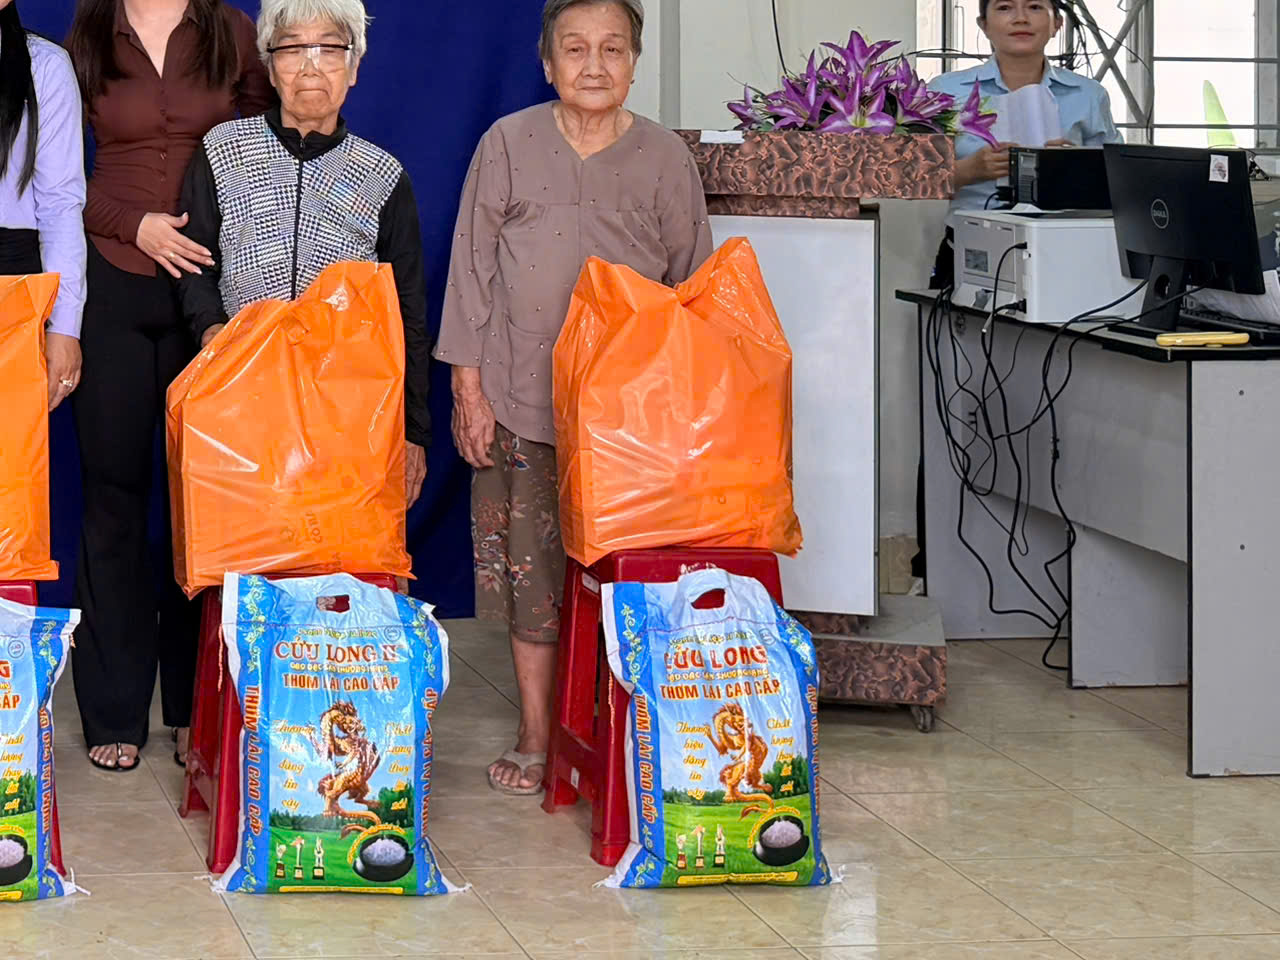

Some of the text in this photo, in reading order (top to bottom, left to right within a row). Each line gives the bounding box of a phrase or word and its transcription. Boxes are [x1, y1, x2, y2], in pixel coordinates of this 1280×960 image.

[275, 636, 319, 660] CỬU
[326, 643, 378, 663] LONG
[709, 645, 768, 669] LONG
[343, 676, 368, 692] CAO
[660, 682, 699, 700] THƠM
[702, 683, 721, 700] LÀI
[725, 680, 752, 698] CAO
